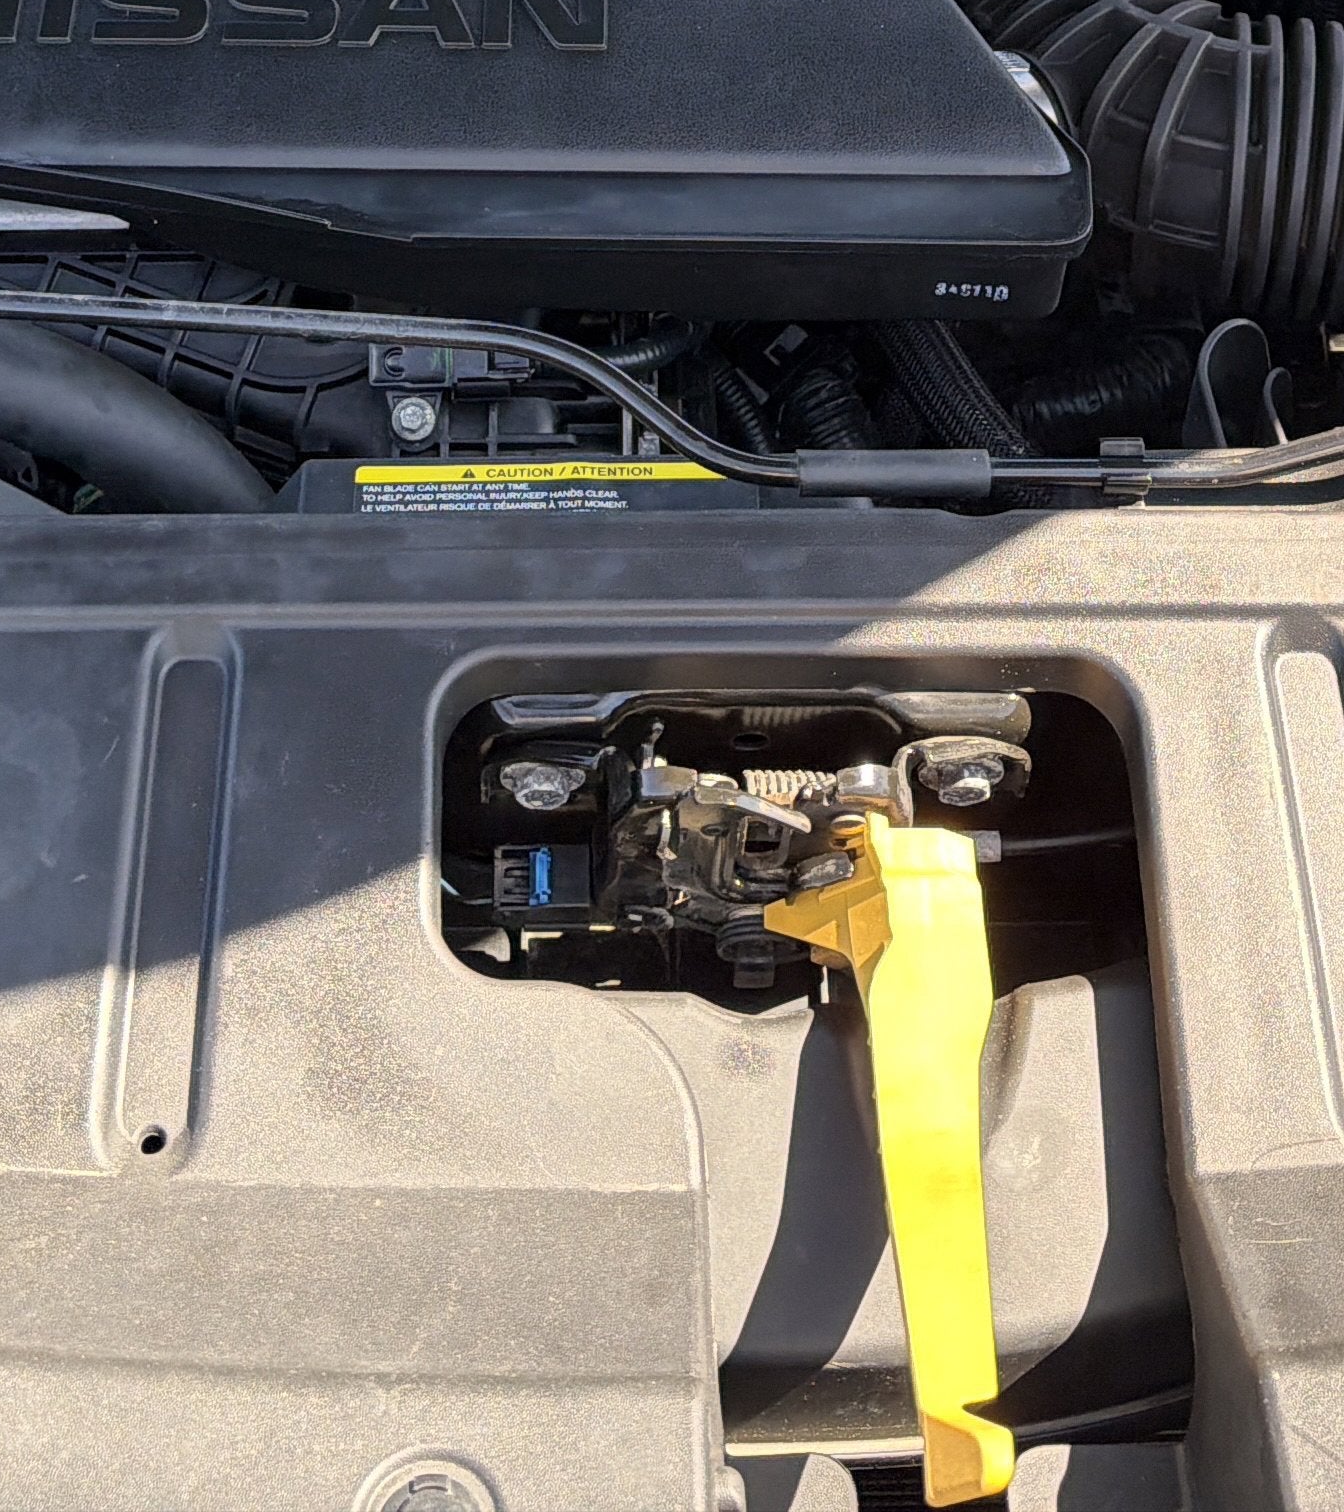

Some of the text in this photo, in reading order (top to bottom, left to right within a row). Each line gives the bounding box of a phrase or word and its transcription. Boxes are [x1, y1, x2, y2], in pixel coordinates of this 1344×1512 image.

[485, 465, 654, 479] CAUTION / ATTENTION
[362, 484, 382, 493] FAN
[383, 484, 415, 493] BLADE
[416, 483, 438, 492] CAN
[440, 483, 470, 492] START
[471, 483, 484, 491] AT
[485, 483, 505, 491] ANY
[362, 494, 376, 502] TO
[377, 493, 403, 502] HELP
[404, 493, 435, 502] AVOID
[436, 492, 488, 501] PERSONAL
[549, 489, 584, 499] HANDS
[360, 499, 629, 513] LE VENTILATEUR RISQUE DE DÉMARRER À TOUT MOMENT.
